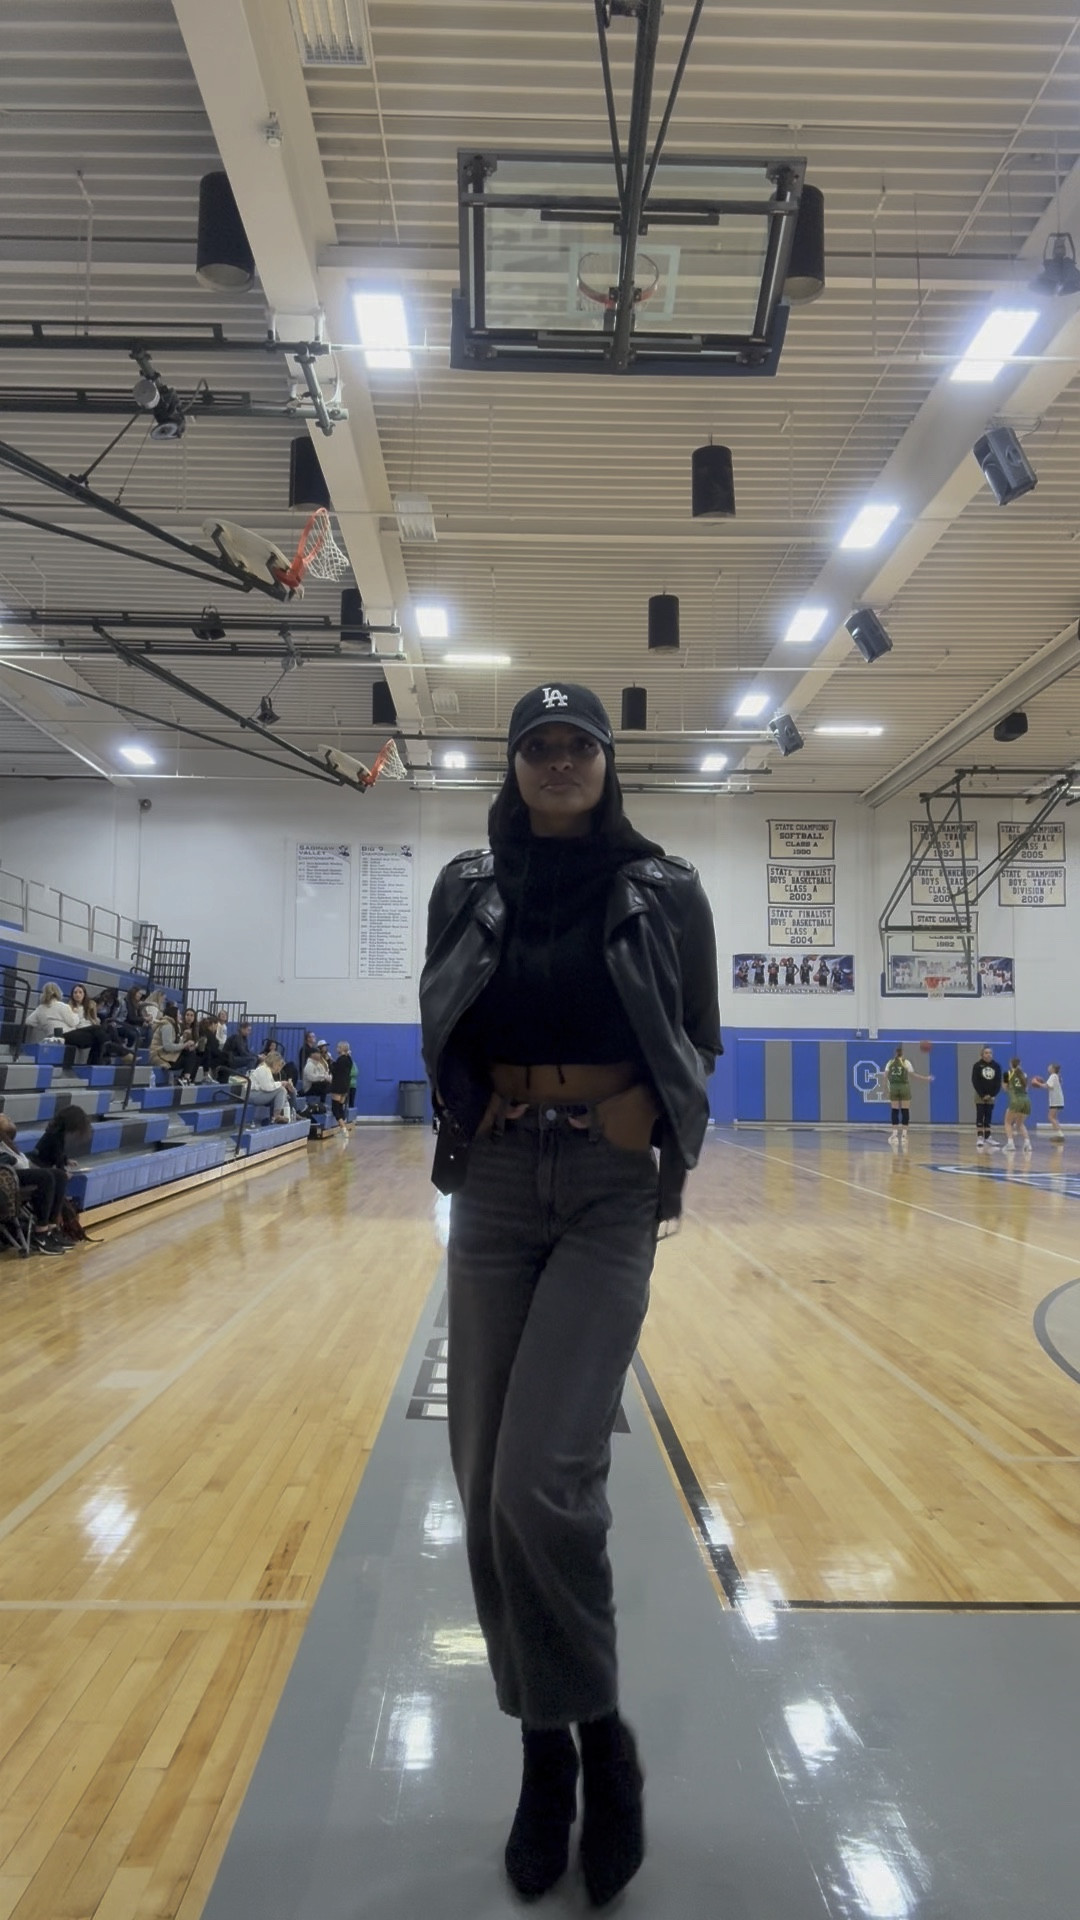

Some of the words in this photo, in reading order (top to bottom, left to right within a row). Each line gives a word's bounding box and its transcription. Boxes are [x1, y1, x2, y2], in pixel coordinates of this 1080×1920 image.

[542, 687, 568, 708] LA
[770, 868, 792, 876] STATE
[798, 868, 832, 876] FINALIST
[892, 1066, 902, 1075] 23
